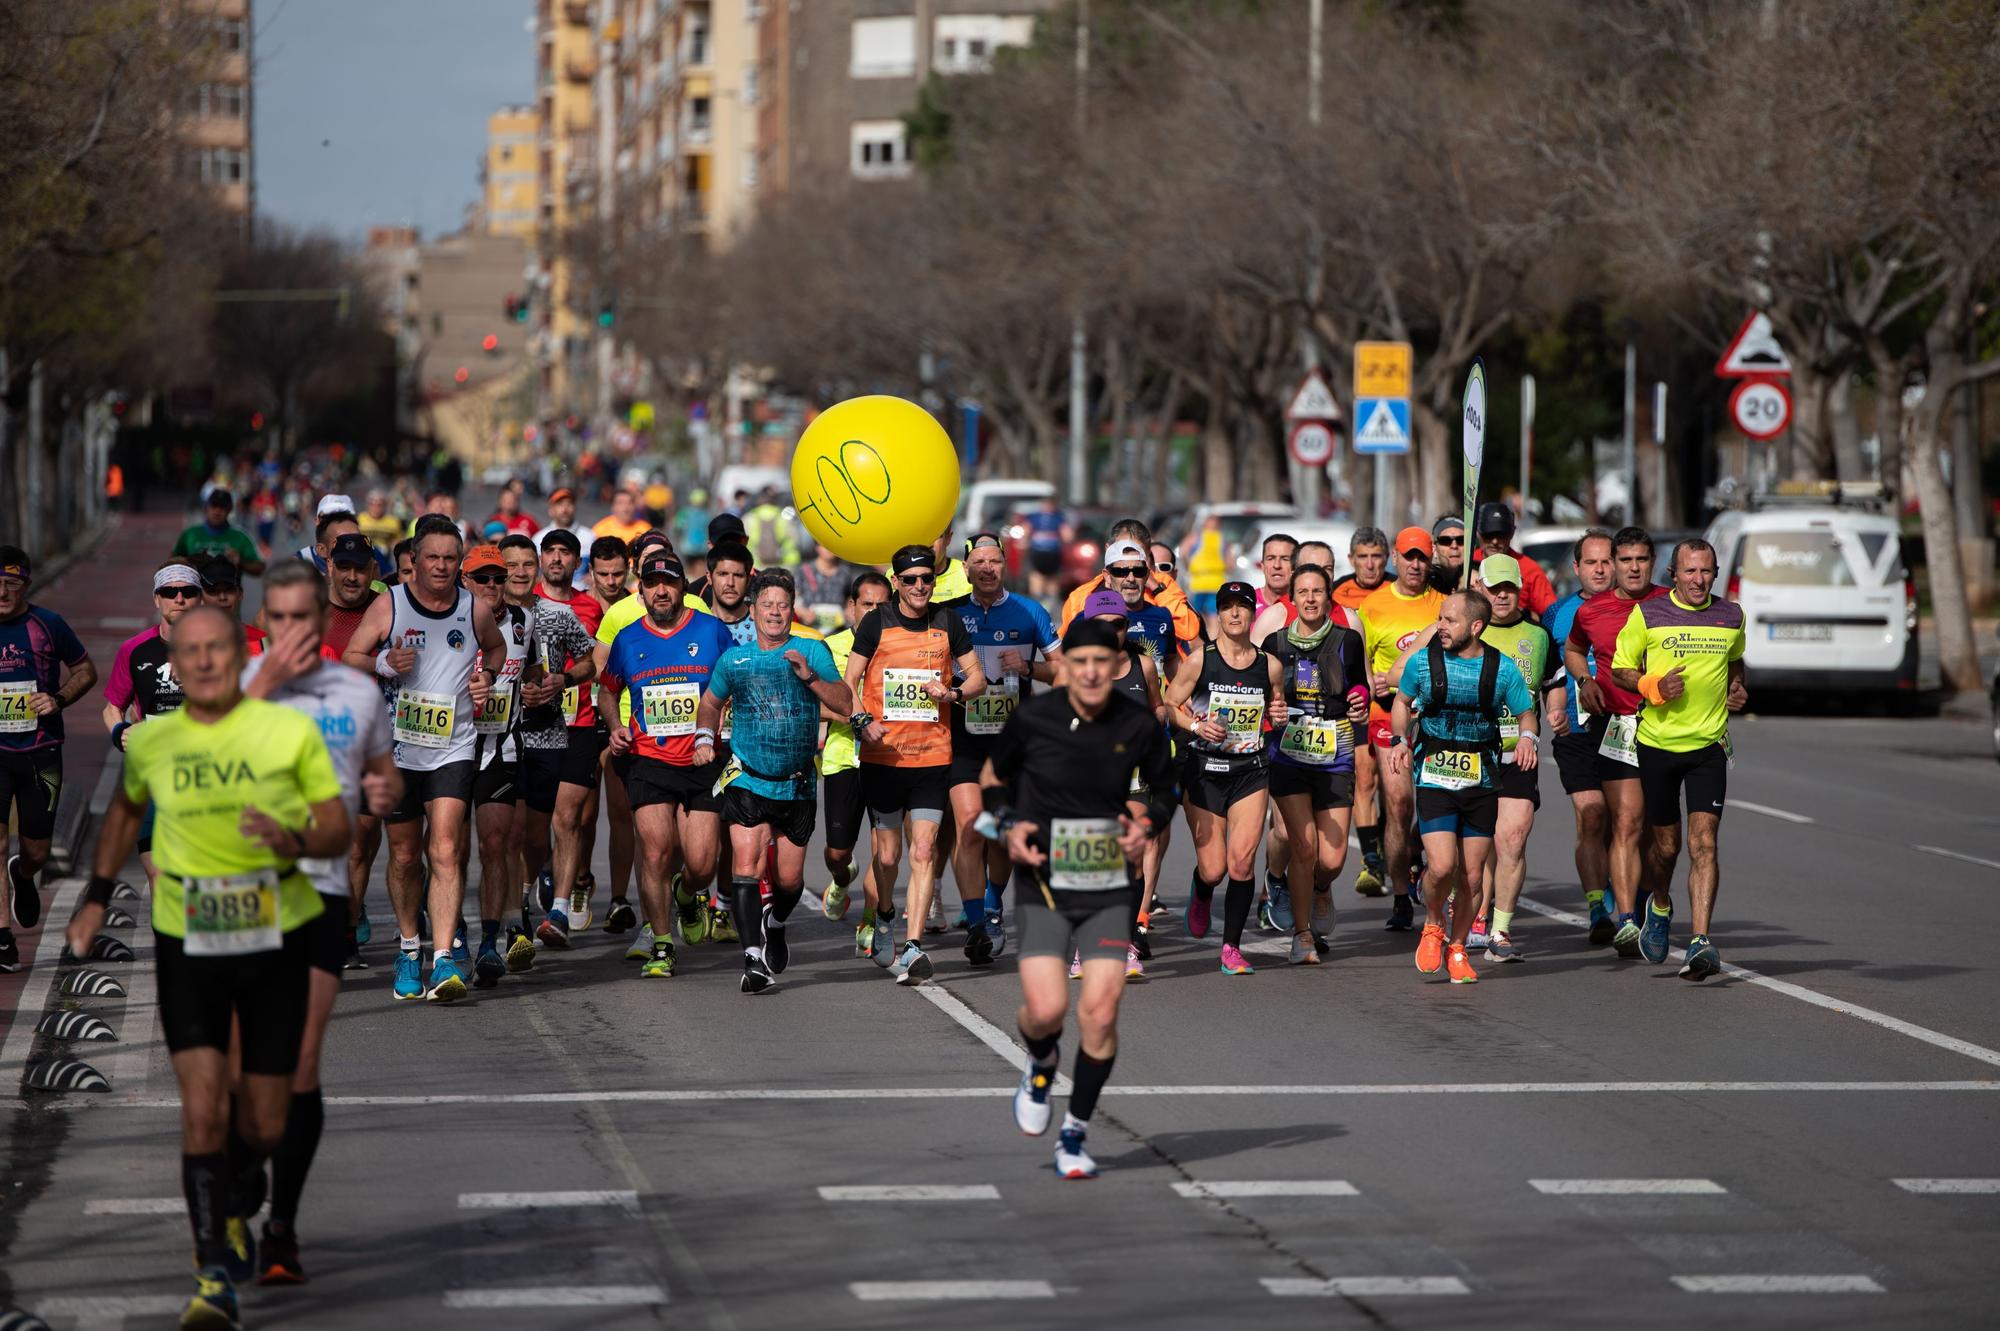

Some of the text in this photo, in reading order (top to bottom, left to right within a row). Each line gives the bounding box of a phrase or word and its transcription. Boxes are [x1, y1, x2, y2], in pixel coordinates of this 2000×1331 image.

[1746, 397, 1780, 421] 20
[650, 676, 688, 685] ALBORAYA
[1208, 681, 1264, 694] Esenciarun
[894, 683, 930, 701] 485
[485, 697, 507, 714] 00
[649, 697, 695, 717] 1169
[888, 700, 913, 709] GAGO
[973, 698, 1015, 717] 1120
[0, 713, 25, 721] ARTIN
[403, 704, 448, 728] 1116
[655, 715, 690, 725] JOSEFO
[405, 723, 440, 735] RAFAEL
[1293, 729, 1327, 748] 814
[1435, 751, 1471, 772] 946
[173, 759, 257, 793] DEVA
[1424, 765, 1479, 781] TBR PERRUQERS
[1060, 839, 1121, 862] 1050
[201, 891, 260, 921] 989
